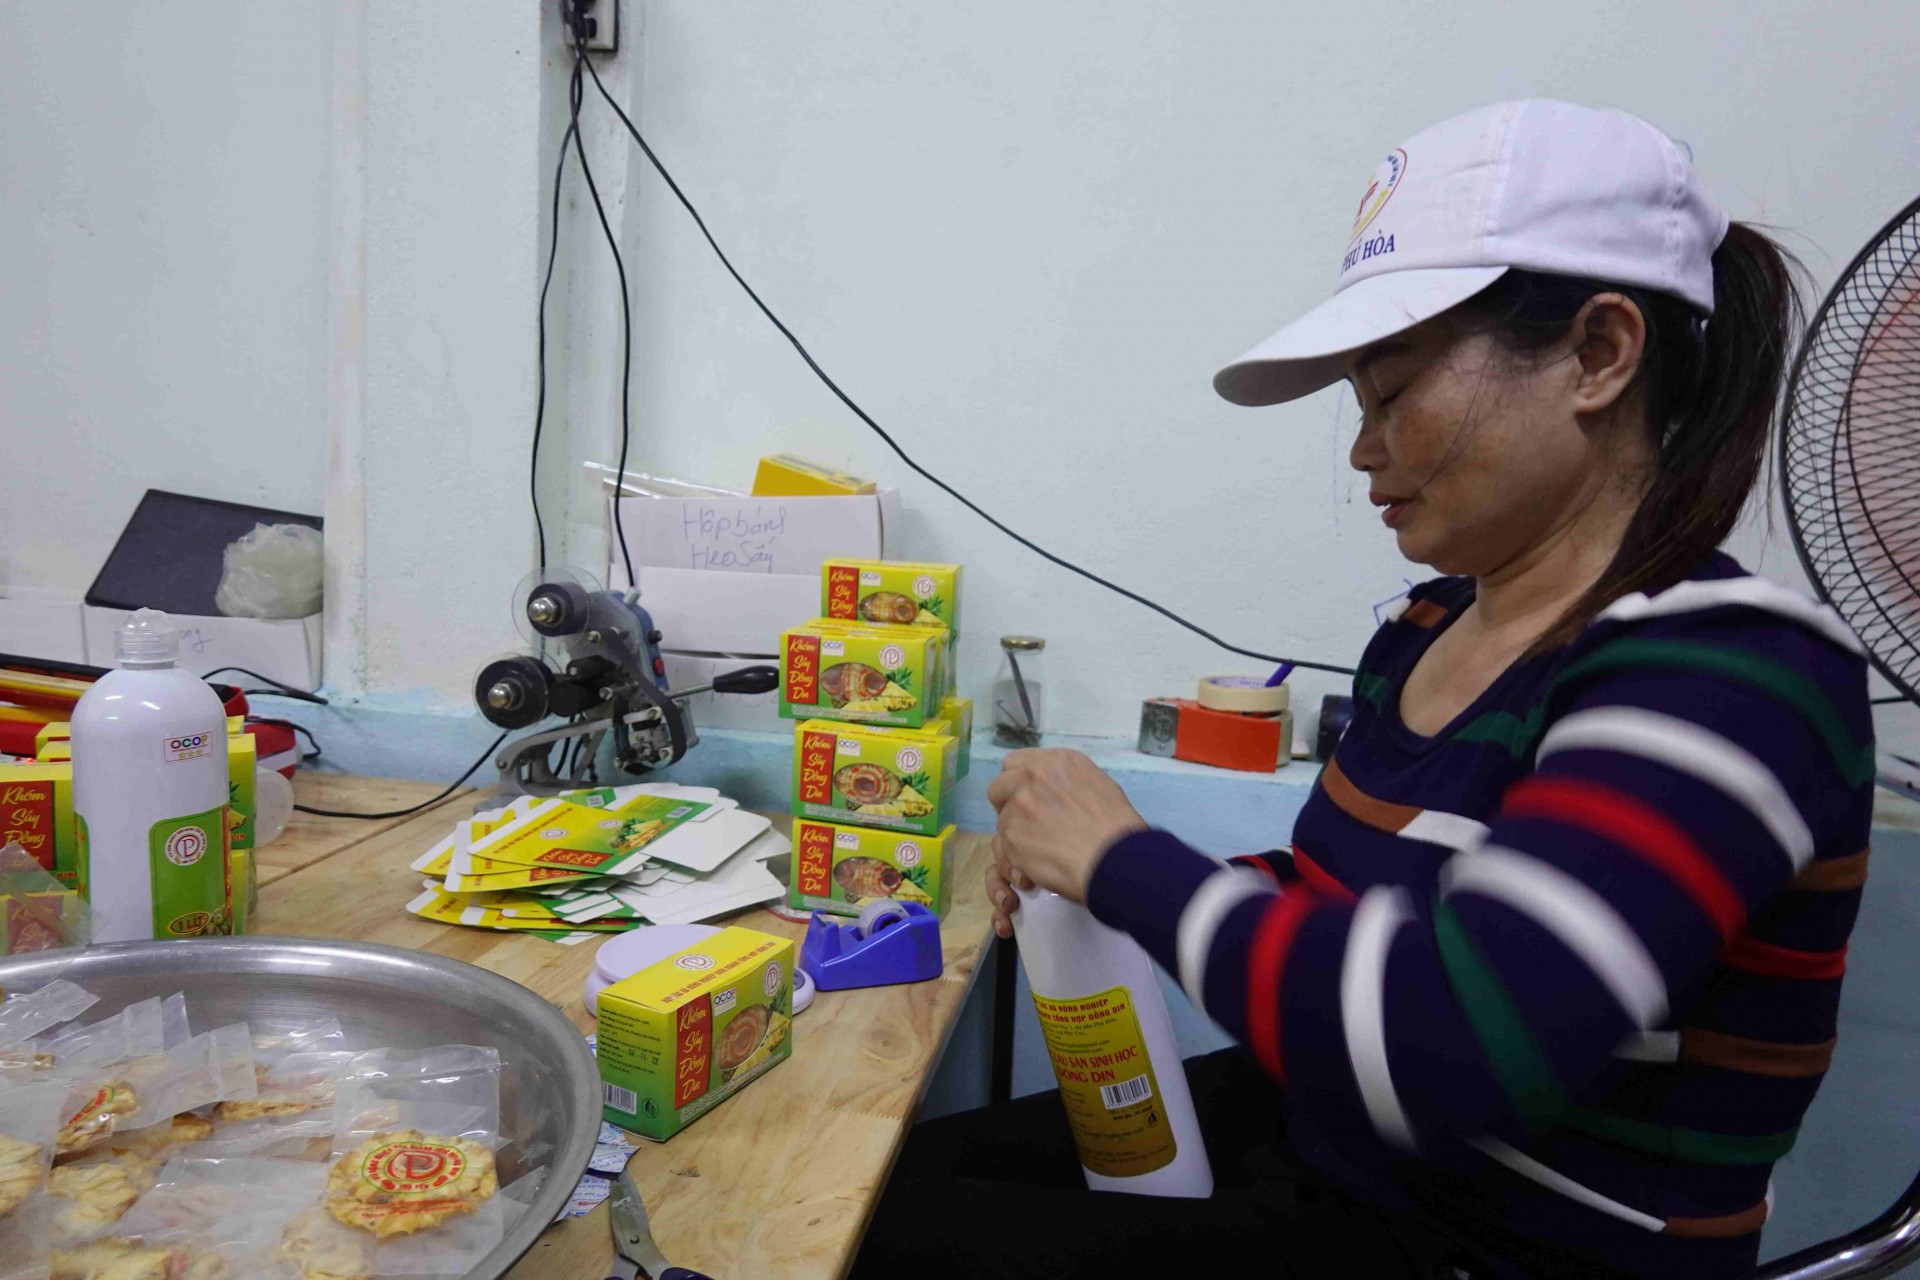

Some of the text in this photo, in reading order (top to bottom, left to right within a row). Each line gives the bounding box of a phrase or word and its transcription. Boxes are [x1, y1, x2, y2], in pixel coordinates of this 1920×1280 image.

[1362, 228, 1395, 260] HÒA
[171, 734, 207, 749] OCOP
[2, 786, 47, 804] Khóm
[9, 808, 41, 829] Sấy
[679, 1006, 706, 1032] Khóm
[682, 1030, 704, 1054] Sấy
[679, 1055, 706, 1079] Đồng
[1090, 1054, 1114, 1068] SINH
[1114, 1045, 1138, 1063] HỌC
[1090, 1068, 1115, 1084] DIN
[682, 1078, 701, 1100] Din
